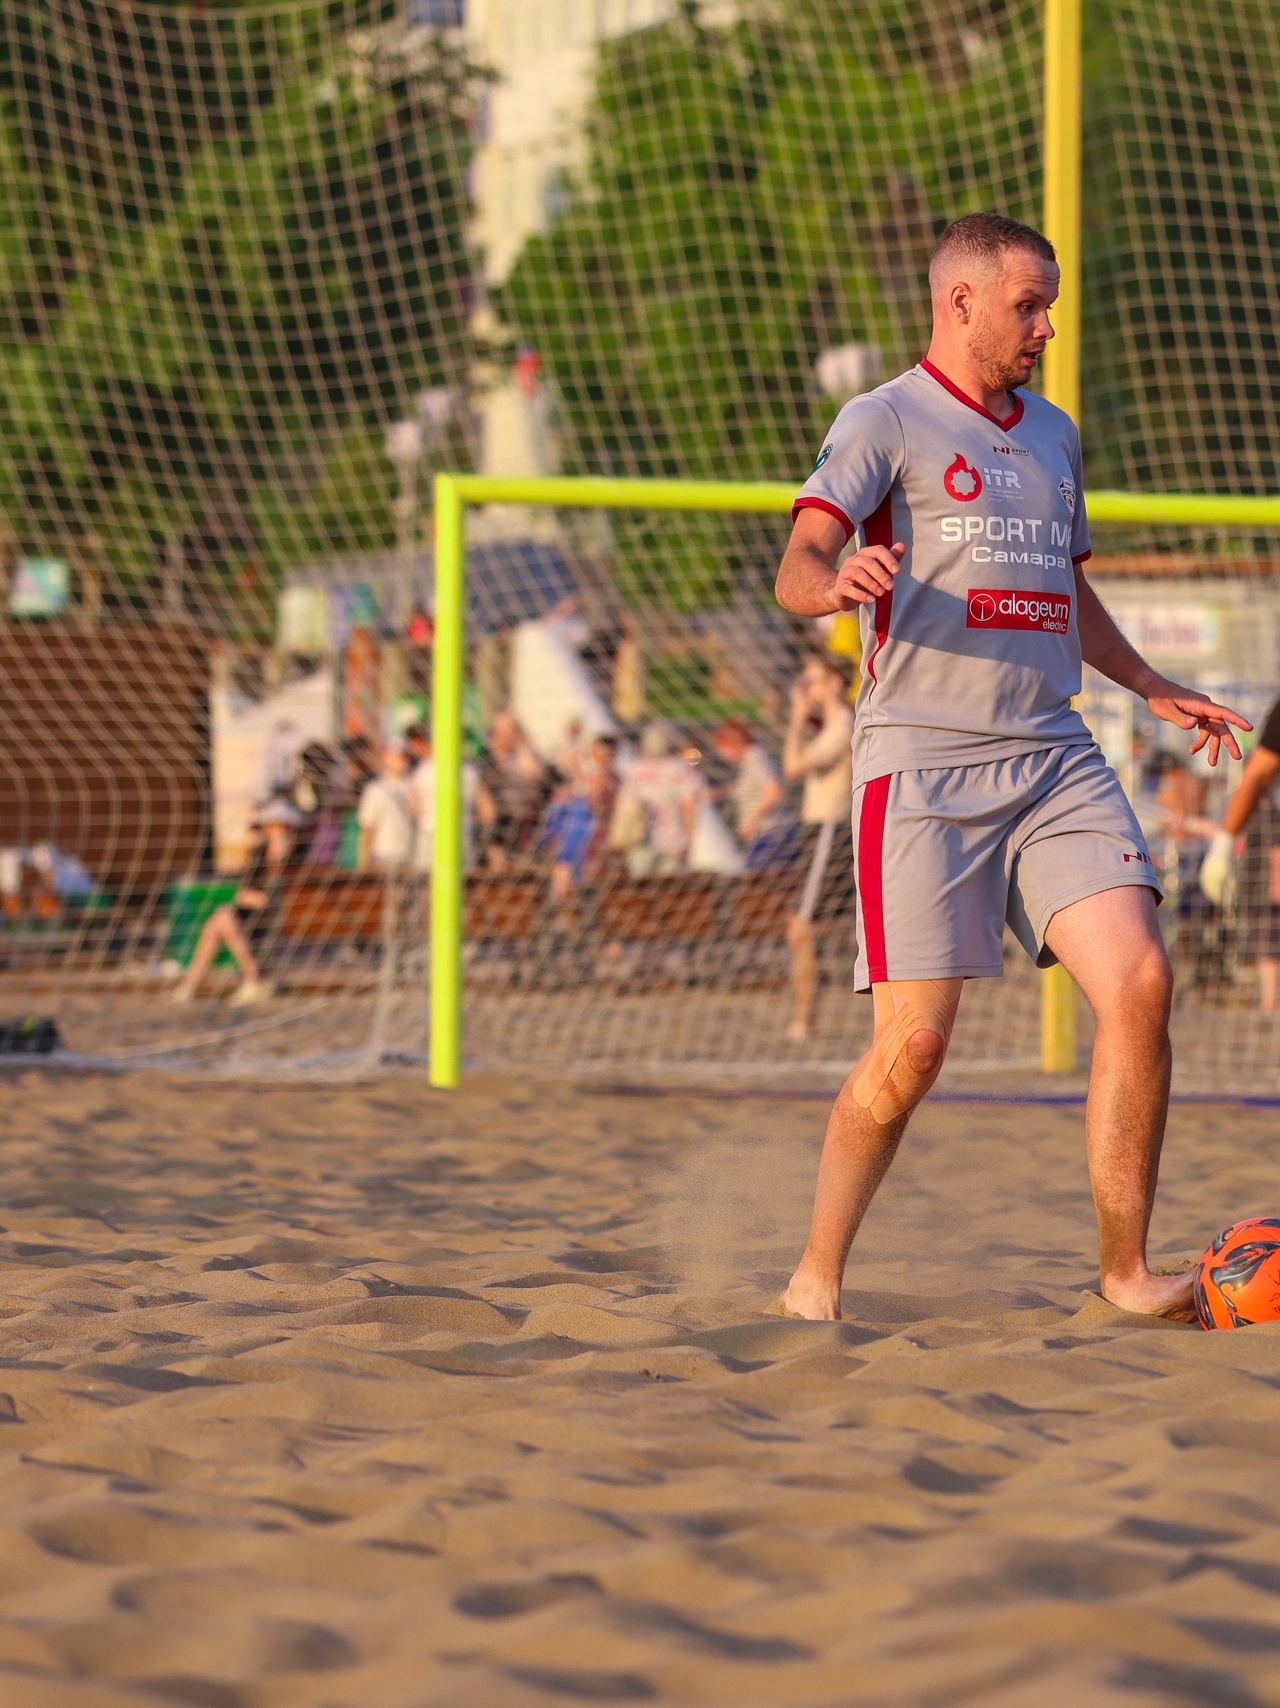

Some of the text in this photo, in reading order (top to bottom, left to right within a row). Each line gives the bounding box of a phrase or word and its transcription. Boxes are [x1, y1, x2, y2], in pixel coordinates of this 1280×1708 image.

[940, 516, 1042, 543] SPORT
[971, 547, 1066, 570] Самара
[999, 593, 1069, 621] alageum
[1042, 619, 1067, 632] electric
